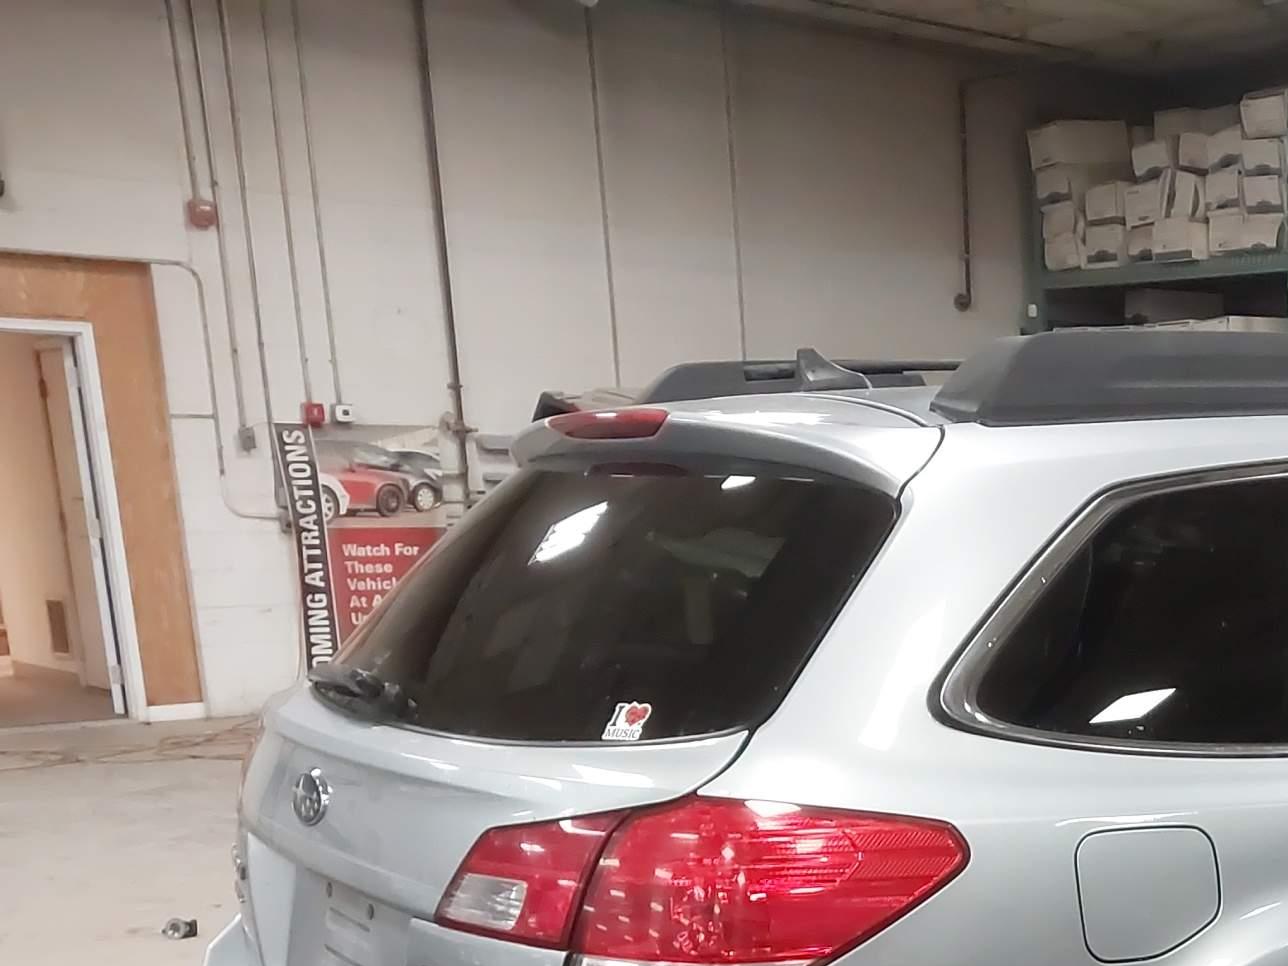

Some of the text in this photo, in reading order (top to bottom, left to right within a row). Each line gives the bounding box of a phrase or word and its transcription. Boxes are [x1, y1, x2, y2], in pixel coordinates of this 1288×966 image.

[282, 429, 333, 668] OMING ATTRACTIONS
[342, 542, 420, 557] Watch For
[344, 561, 393, 574] These
[346, 576, 397, 591] Vehicl
[349, 594, 368, 608] At
[609, 705, 626, 727] I
[605, 728, 640, 739] MUSIC
